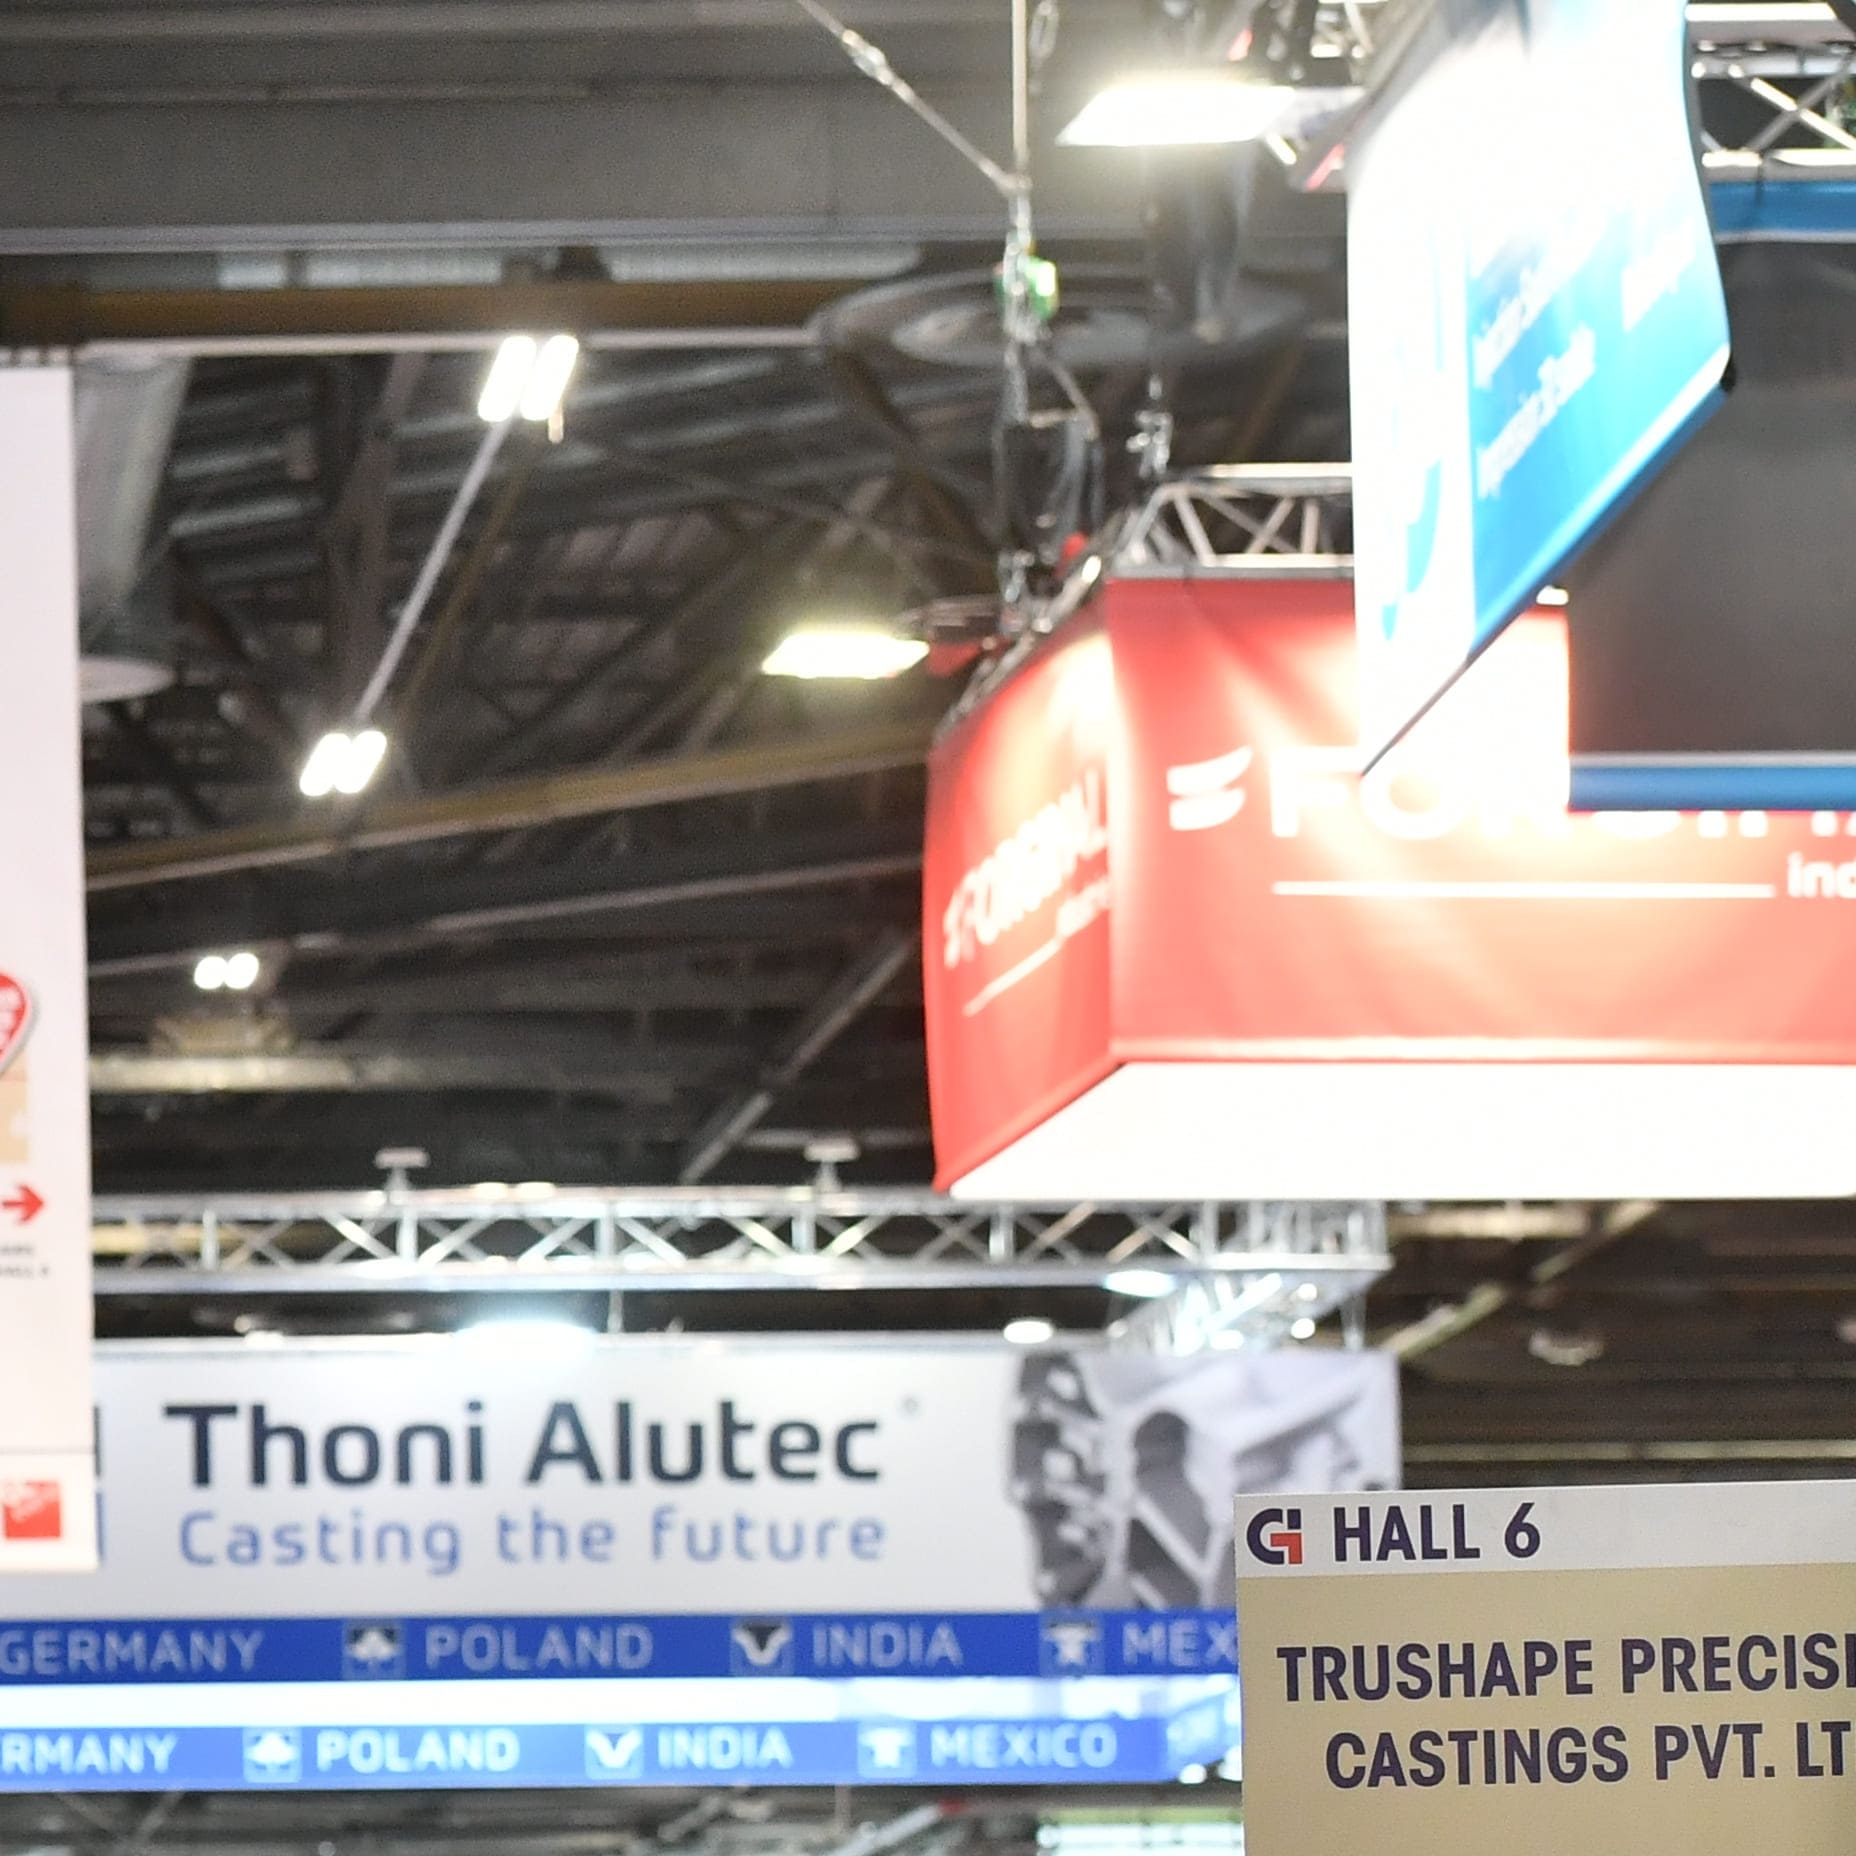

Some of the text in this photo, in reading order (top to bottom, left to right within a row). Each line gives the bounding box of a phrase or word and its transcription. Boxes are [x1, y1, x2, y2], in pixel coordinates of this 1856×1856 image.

[163, 1397, 883, 1488] Thoni Alutec
[179, 1506, 887, 1576] Casting the future
[1333, 1502, 1542, 1562] HALL 6
[424, 1622, 655, 1673] POLAND
[813, 1621, 964, 1669] INDIA
[1276, 1639, 1594, 1702] TRUSHAPE
[316, 1728, 521, 1774] POLAND
[657, 1724, 794, 1770] INDIA
[930, 1720, 1119, 1769] MEXICO
[1325, 1725, 1629, 1788] CASTINGS
[1654, 1723, 1777, 1780] PVT.
